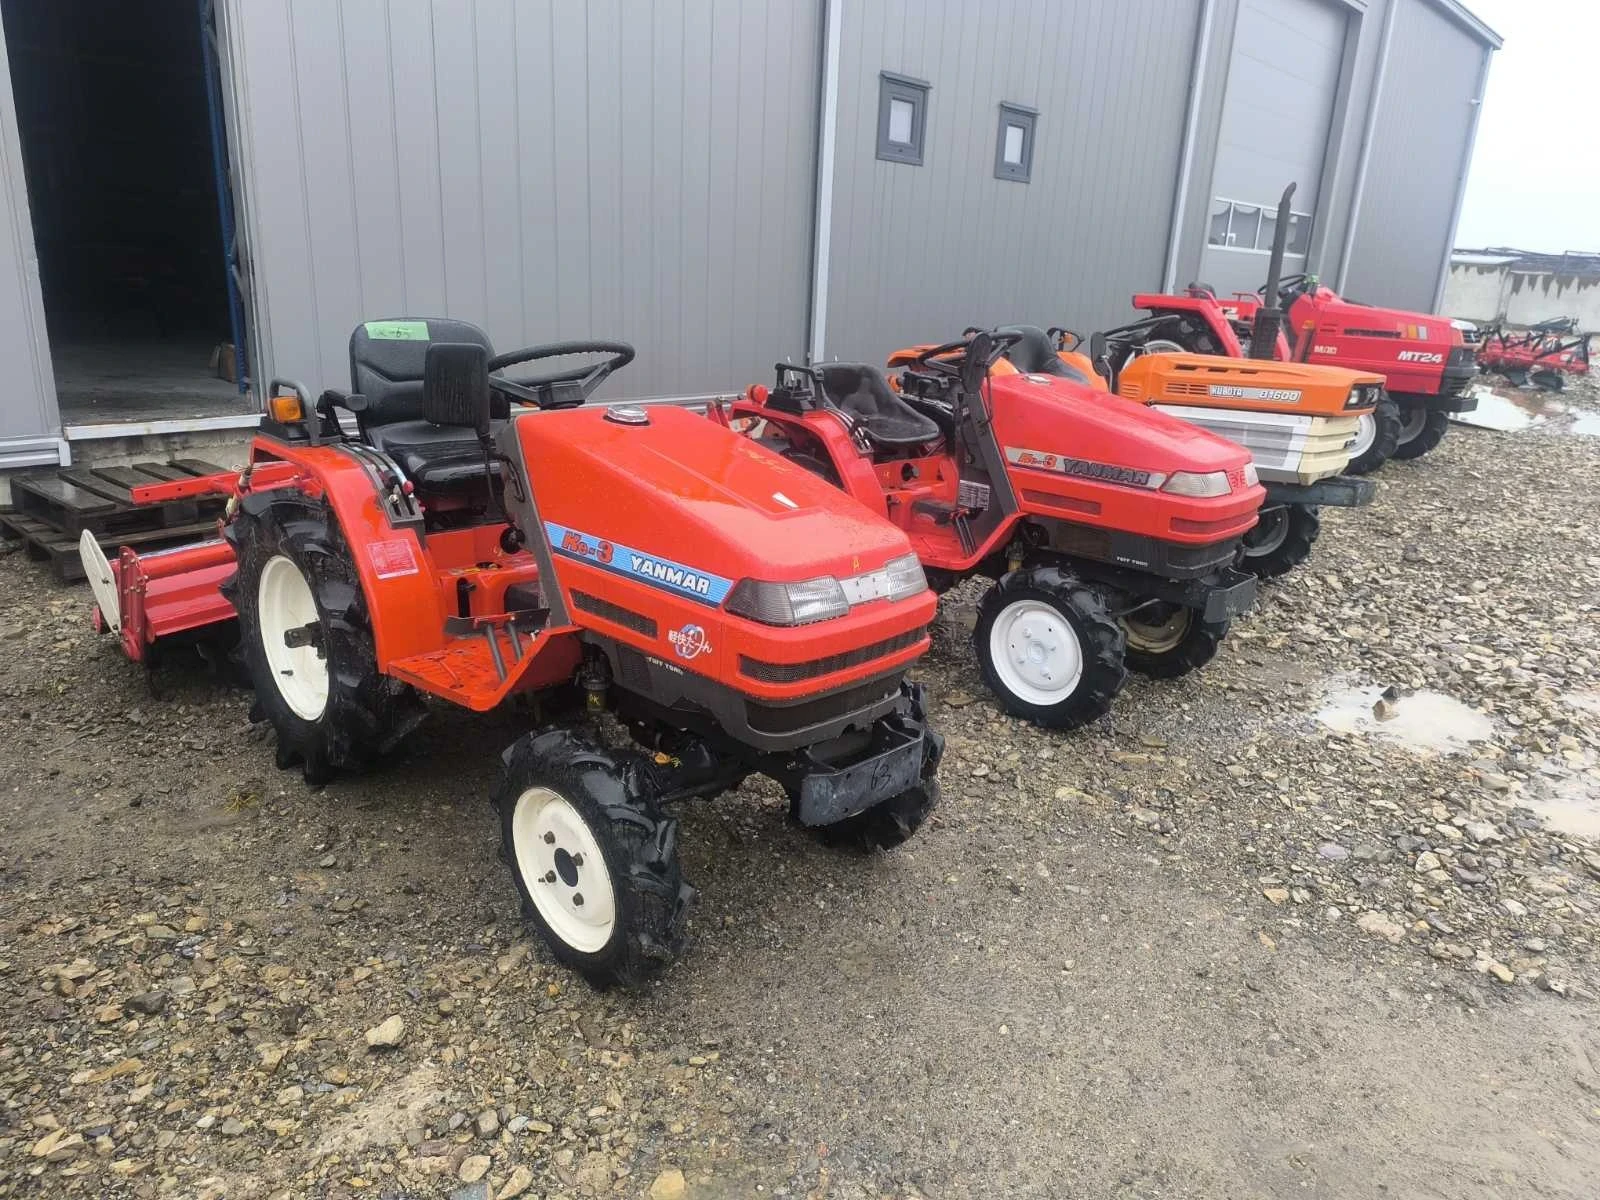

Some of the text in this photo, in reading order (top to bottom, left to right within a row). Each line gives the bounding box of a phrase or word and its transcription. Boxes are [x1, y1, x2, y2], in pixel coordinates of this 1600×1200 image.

[1398, 350, 1443, 364] MT24
[1063, 458, 1152, 486] YANMAR
[630, 553, 711, 596] YANMAR
